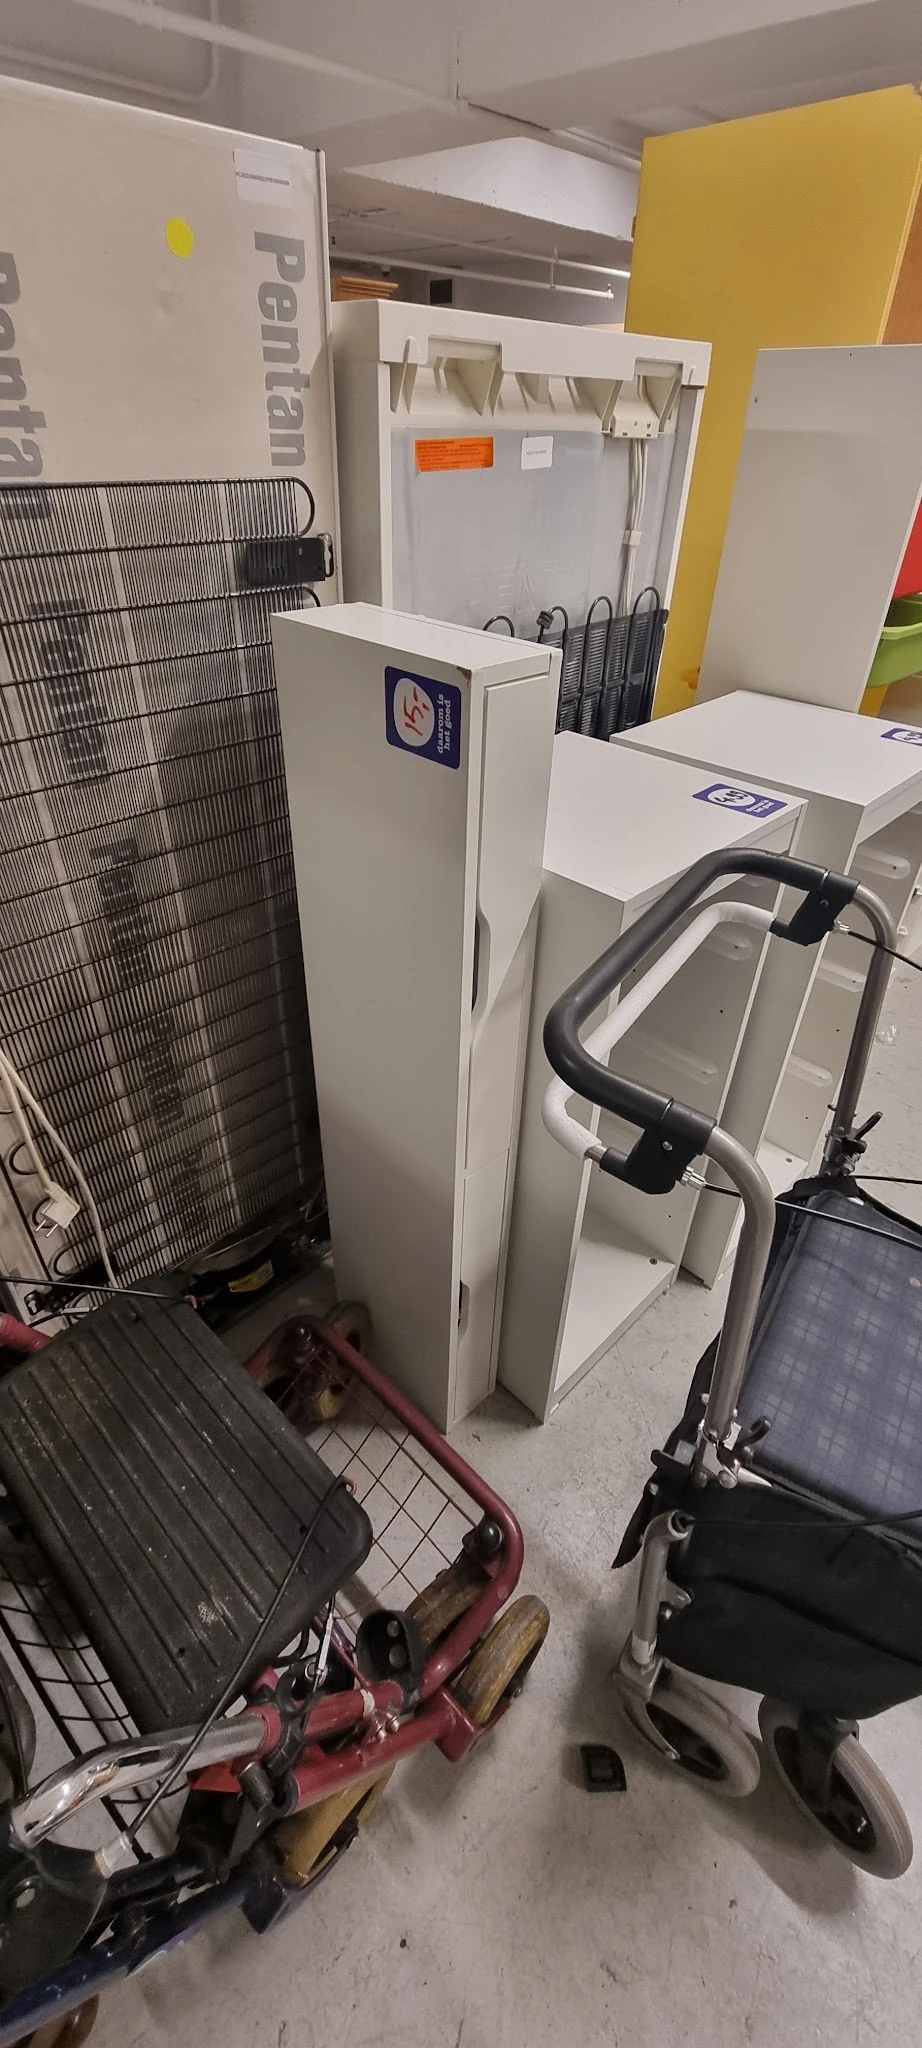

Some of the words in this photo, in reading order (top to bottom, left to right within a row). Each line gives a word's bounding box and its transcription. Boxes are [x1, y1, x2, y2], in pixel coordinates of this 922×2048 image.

[254, 231, 310, 467] Pentan
[27, 599, 110, 789] Pentan
[437, 694, 444, 705] is
[444, 699, 452, 730] goed
